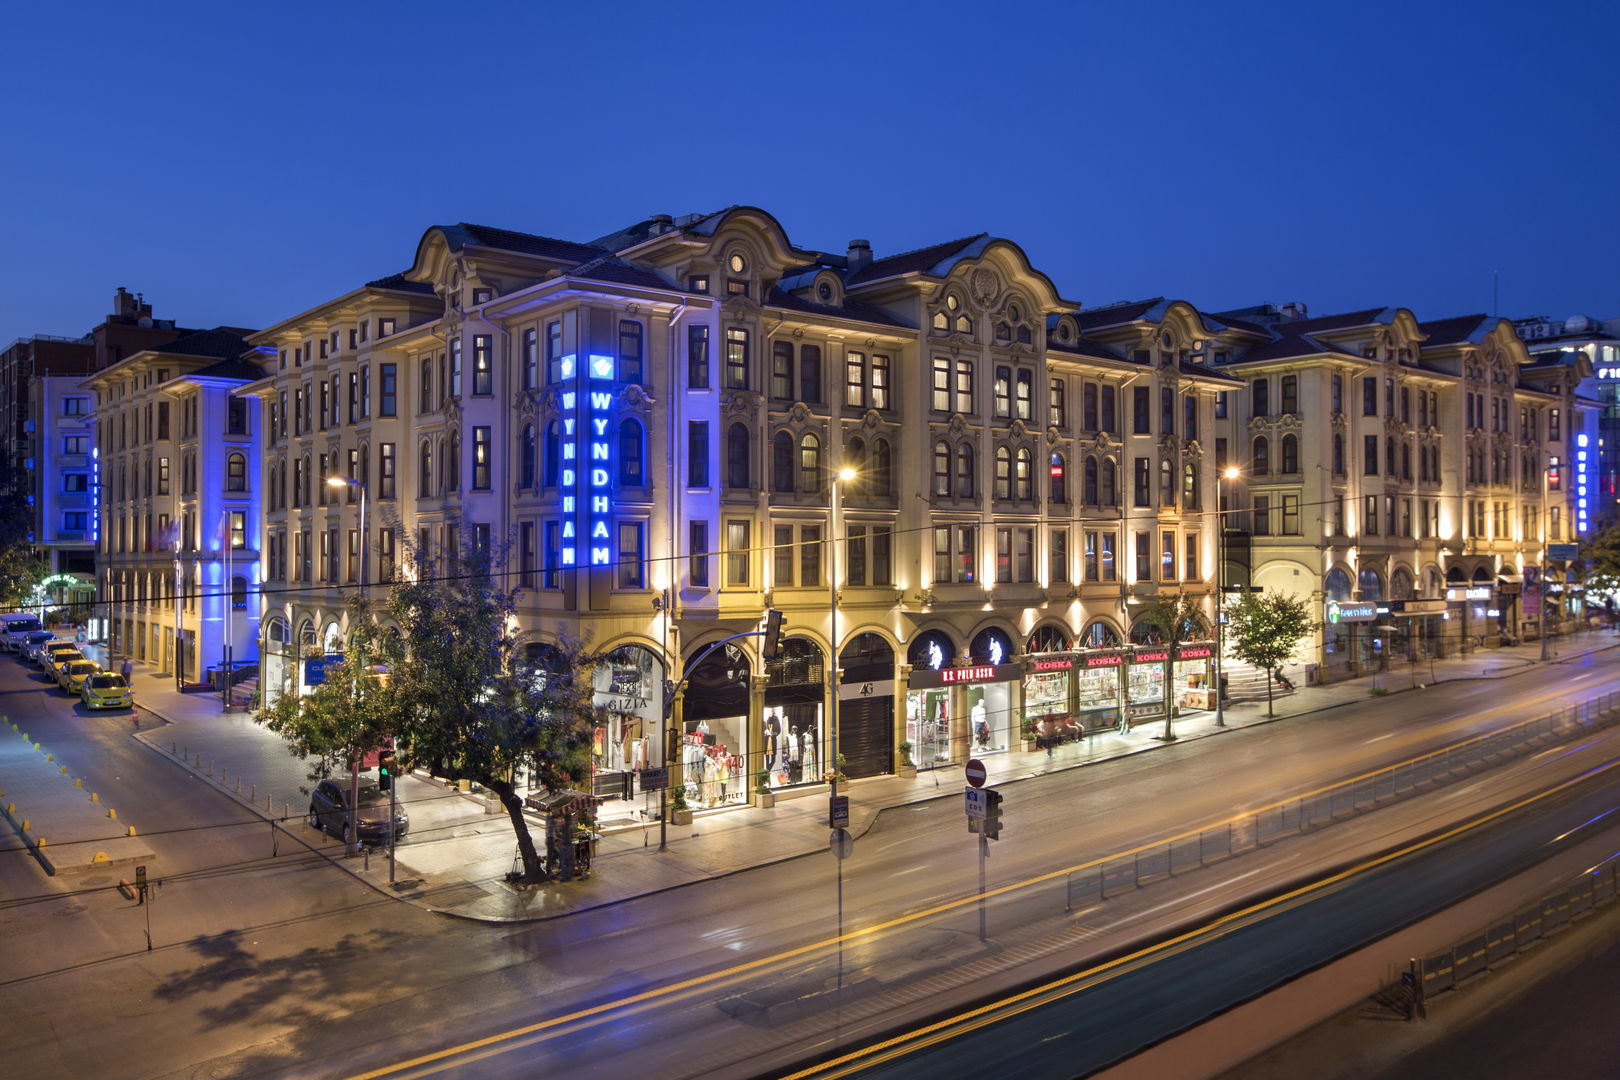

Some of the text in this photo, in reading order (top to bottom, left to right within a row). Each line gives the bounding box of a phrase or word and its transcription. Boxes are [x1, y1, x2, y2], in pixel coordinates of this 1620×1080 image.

[591, 392, 612, 565] WYNDHAM
[1136, 653, 1169, 662] KOSKA
[1181, 649, 1211, 659] KOSKA
[1035, 661, 1073, 671] KOSKA
[1087, 656, 1123, 666] KOSKA
[943, 671, 955, 682] U.S.
[957, 669, 974, 680] POLO
[608, 698, 648, 711] GIZIA
